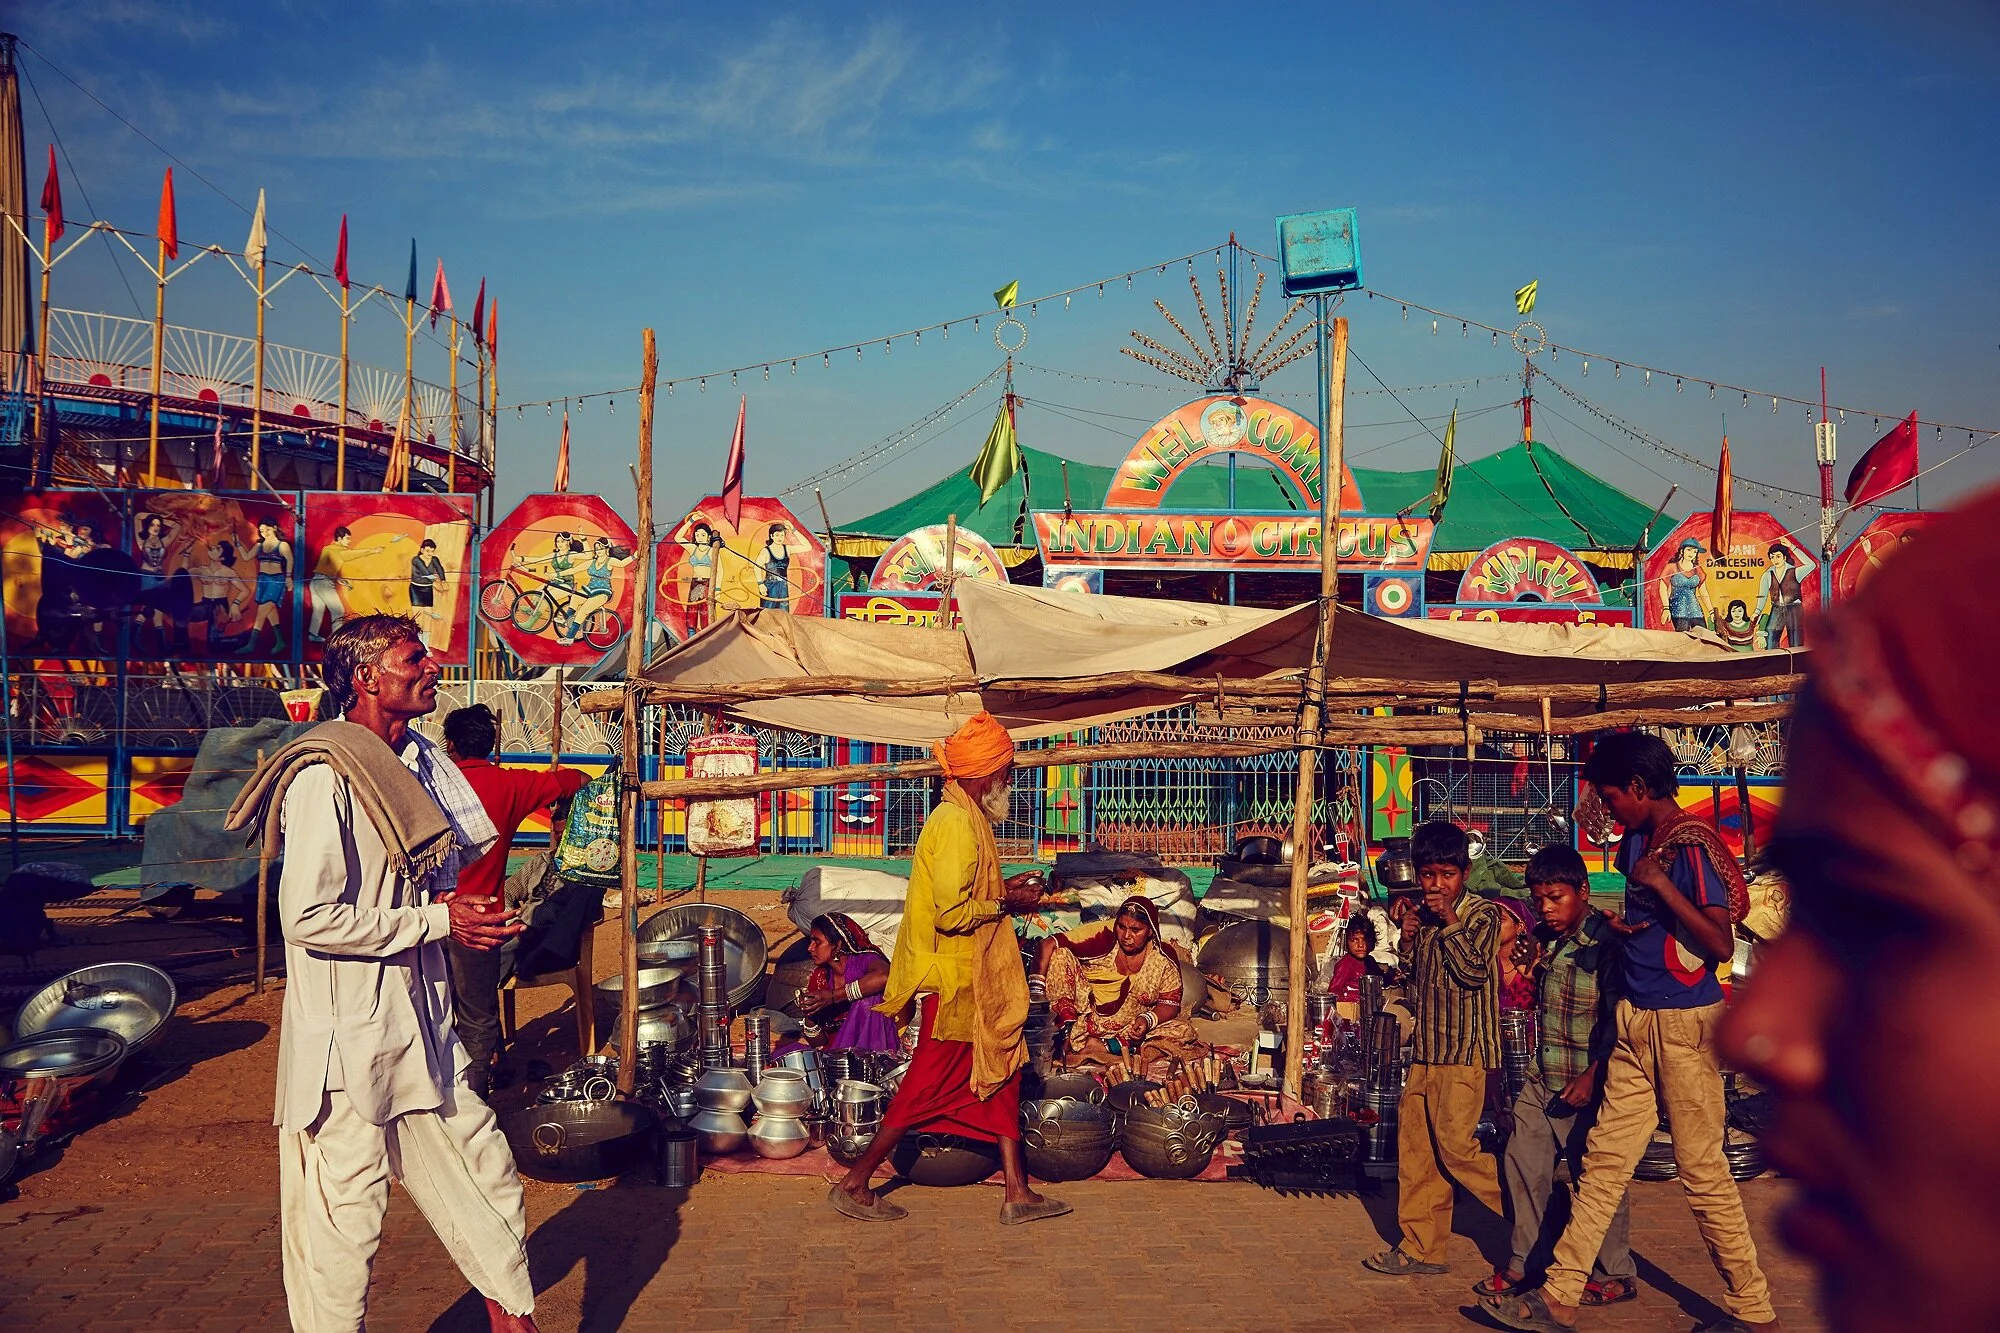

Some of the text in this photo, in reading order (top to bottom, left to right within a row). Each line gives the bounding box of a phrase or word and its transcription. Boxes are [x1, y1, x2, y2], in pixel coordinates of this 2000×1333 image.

[1048, 518, 1419, 558] INDIAN CIRCUS
[1715, 570, 1755, 580] DOLL
